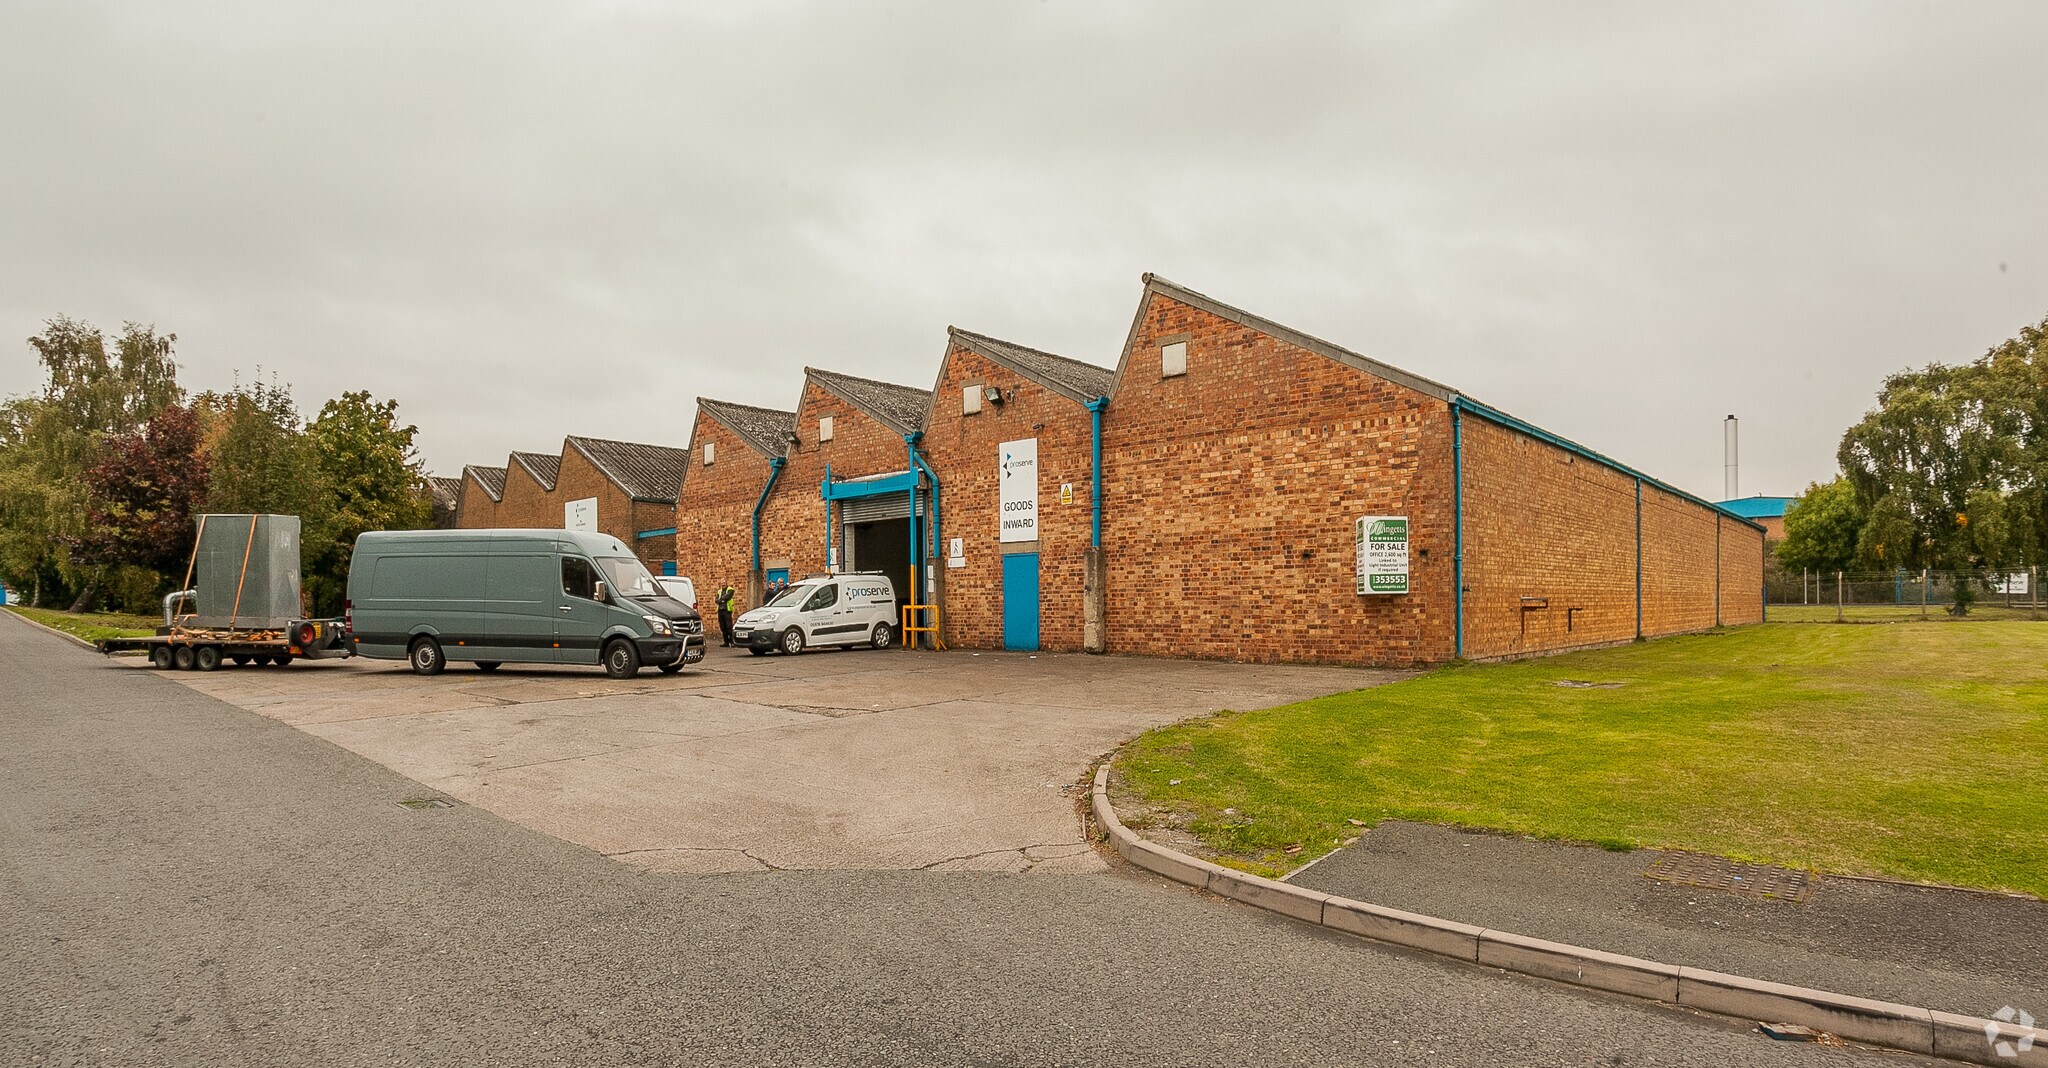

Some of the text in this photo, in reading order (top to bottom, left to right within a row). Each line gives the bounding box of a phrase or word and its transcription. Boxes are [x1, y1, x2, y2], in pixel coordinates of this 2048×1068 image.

[1009, 459, 1033, 469] proserve
[1004, 500, 1033, 512] GOODS
[1003, 518, 1034, 530] INWARD
[1375, 575, 1405, 584] 353553
[851, 586, 890, 599] proserve
